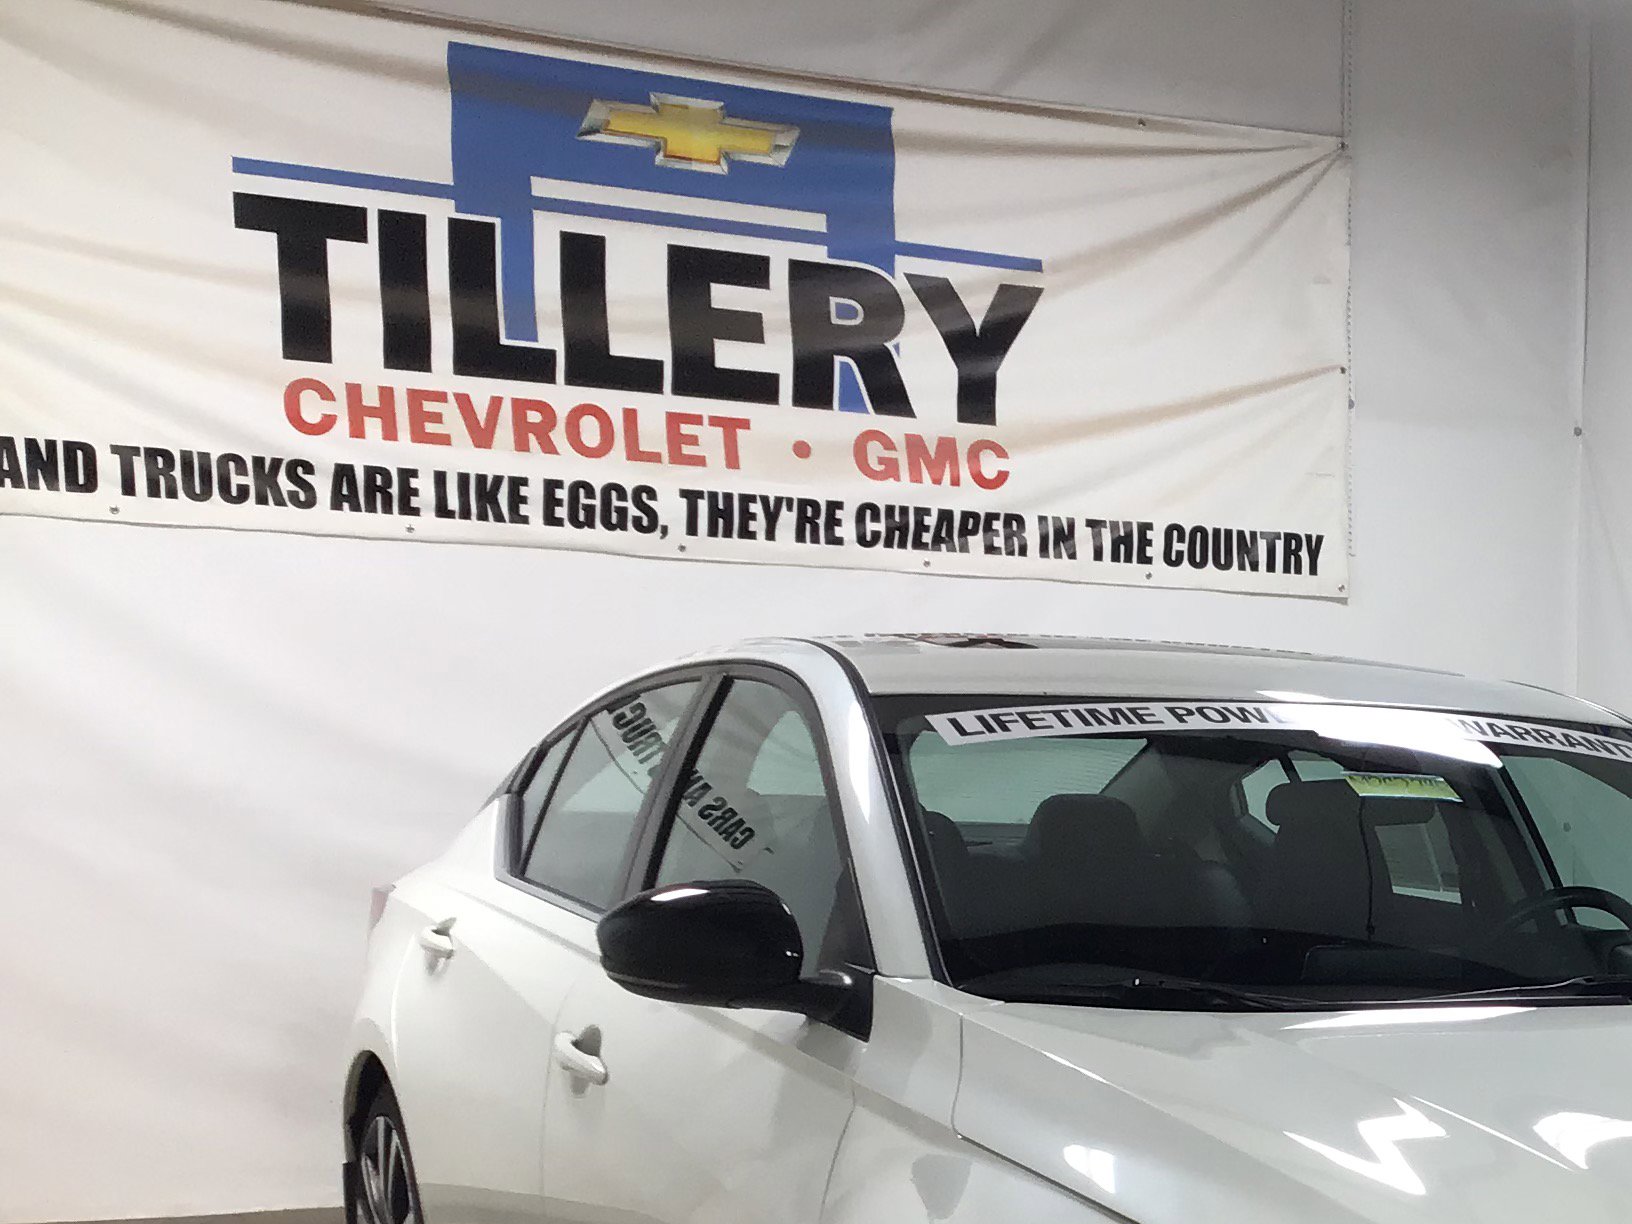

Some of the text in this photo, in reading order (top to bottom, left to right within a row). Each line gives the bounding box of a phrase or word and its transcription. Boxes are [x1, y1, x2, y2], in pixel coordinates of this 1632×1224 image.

[233, 191, 1044, 426] TILLERY
[283, 377, 1010, 490] CHEVROLET GMC
[0, 435, 1324, 577] AND TRUCKS ARE LIKE EGGS, THEY'RE CHEAPER IN THE COUNTRY
[946, 705, 1165, 737] LIFETIME
